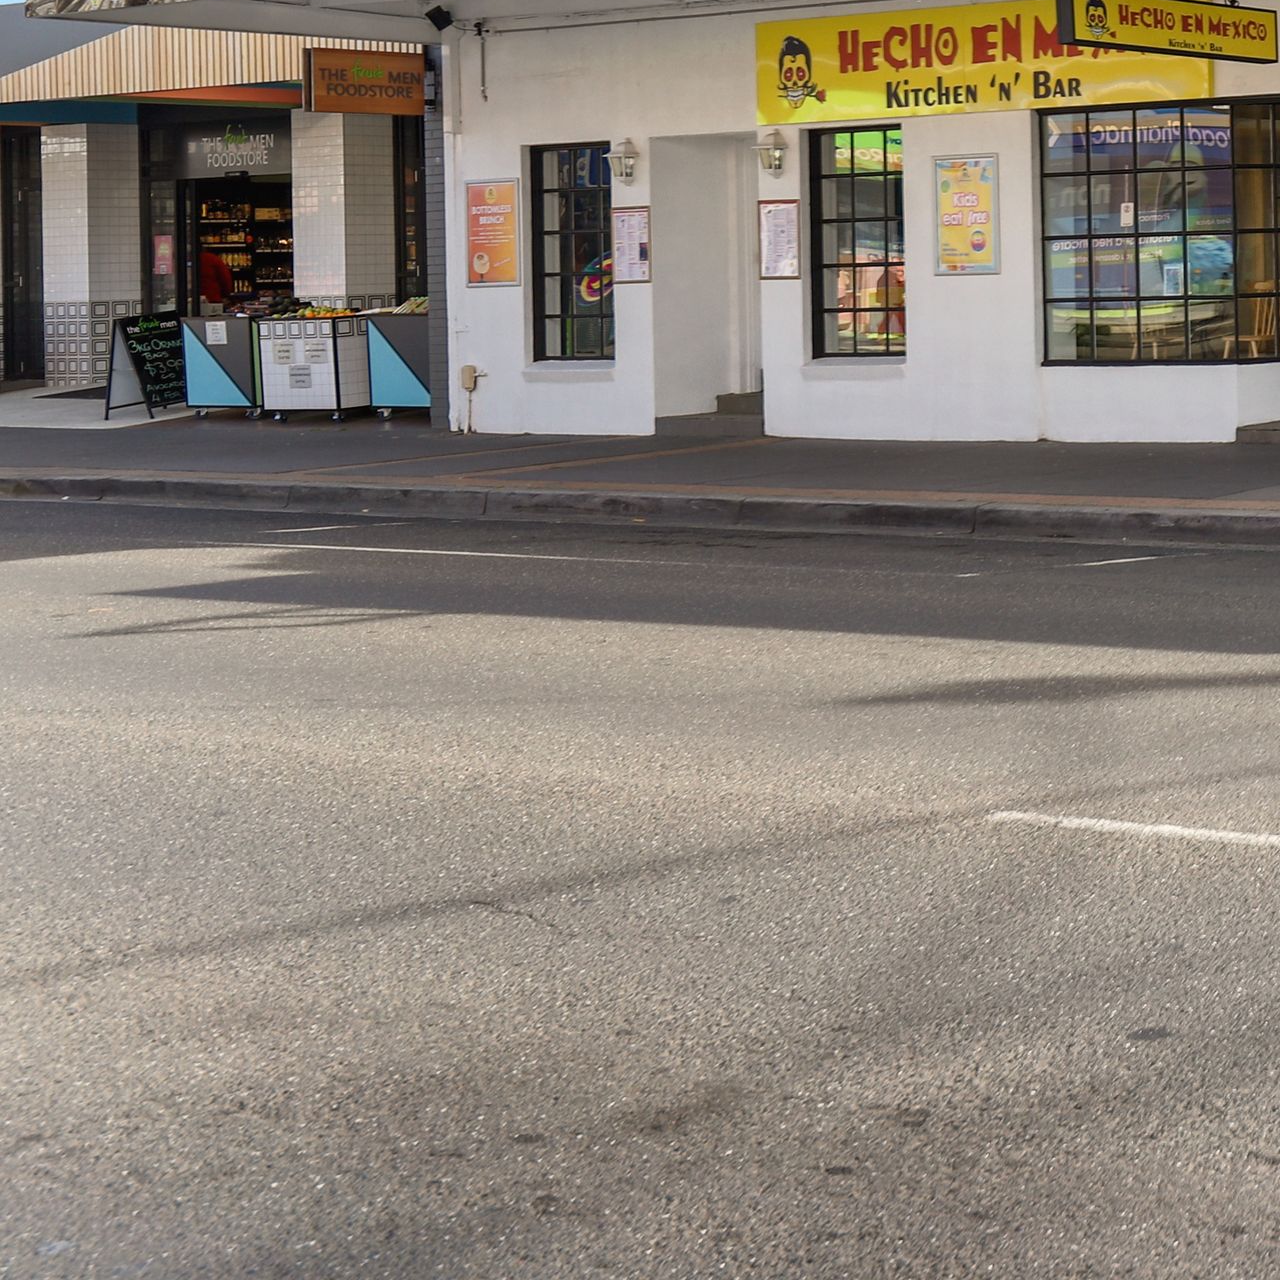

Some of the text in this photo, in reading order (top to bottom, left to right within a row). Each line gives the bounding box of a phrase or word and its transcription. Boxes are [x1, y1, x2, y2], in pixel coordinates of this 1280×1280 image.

[1118, 4, 1267, 41] HECHO EN MEXICO
[838, 23, 959, 73] HECHO
[971, 14, 1022, 63] EN
[319, 67, 347, 82] THE
[388, 71, 421, 85] MEN
[326, 82, 413, 98] FOODSTORE
[202, 136, 221, 150] THE
[250, 133, 274, 149] MEN
[207, 151, 268, 168] FOODSTORE
[952, 192, 979, 208] Kids
[943, 210, 989, 227] eat free
[126, 326, 140, 334] the
[160, 320, 177, 329] men
